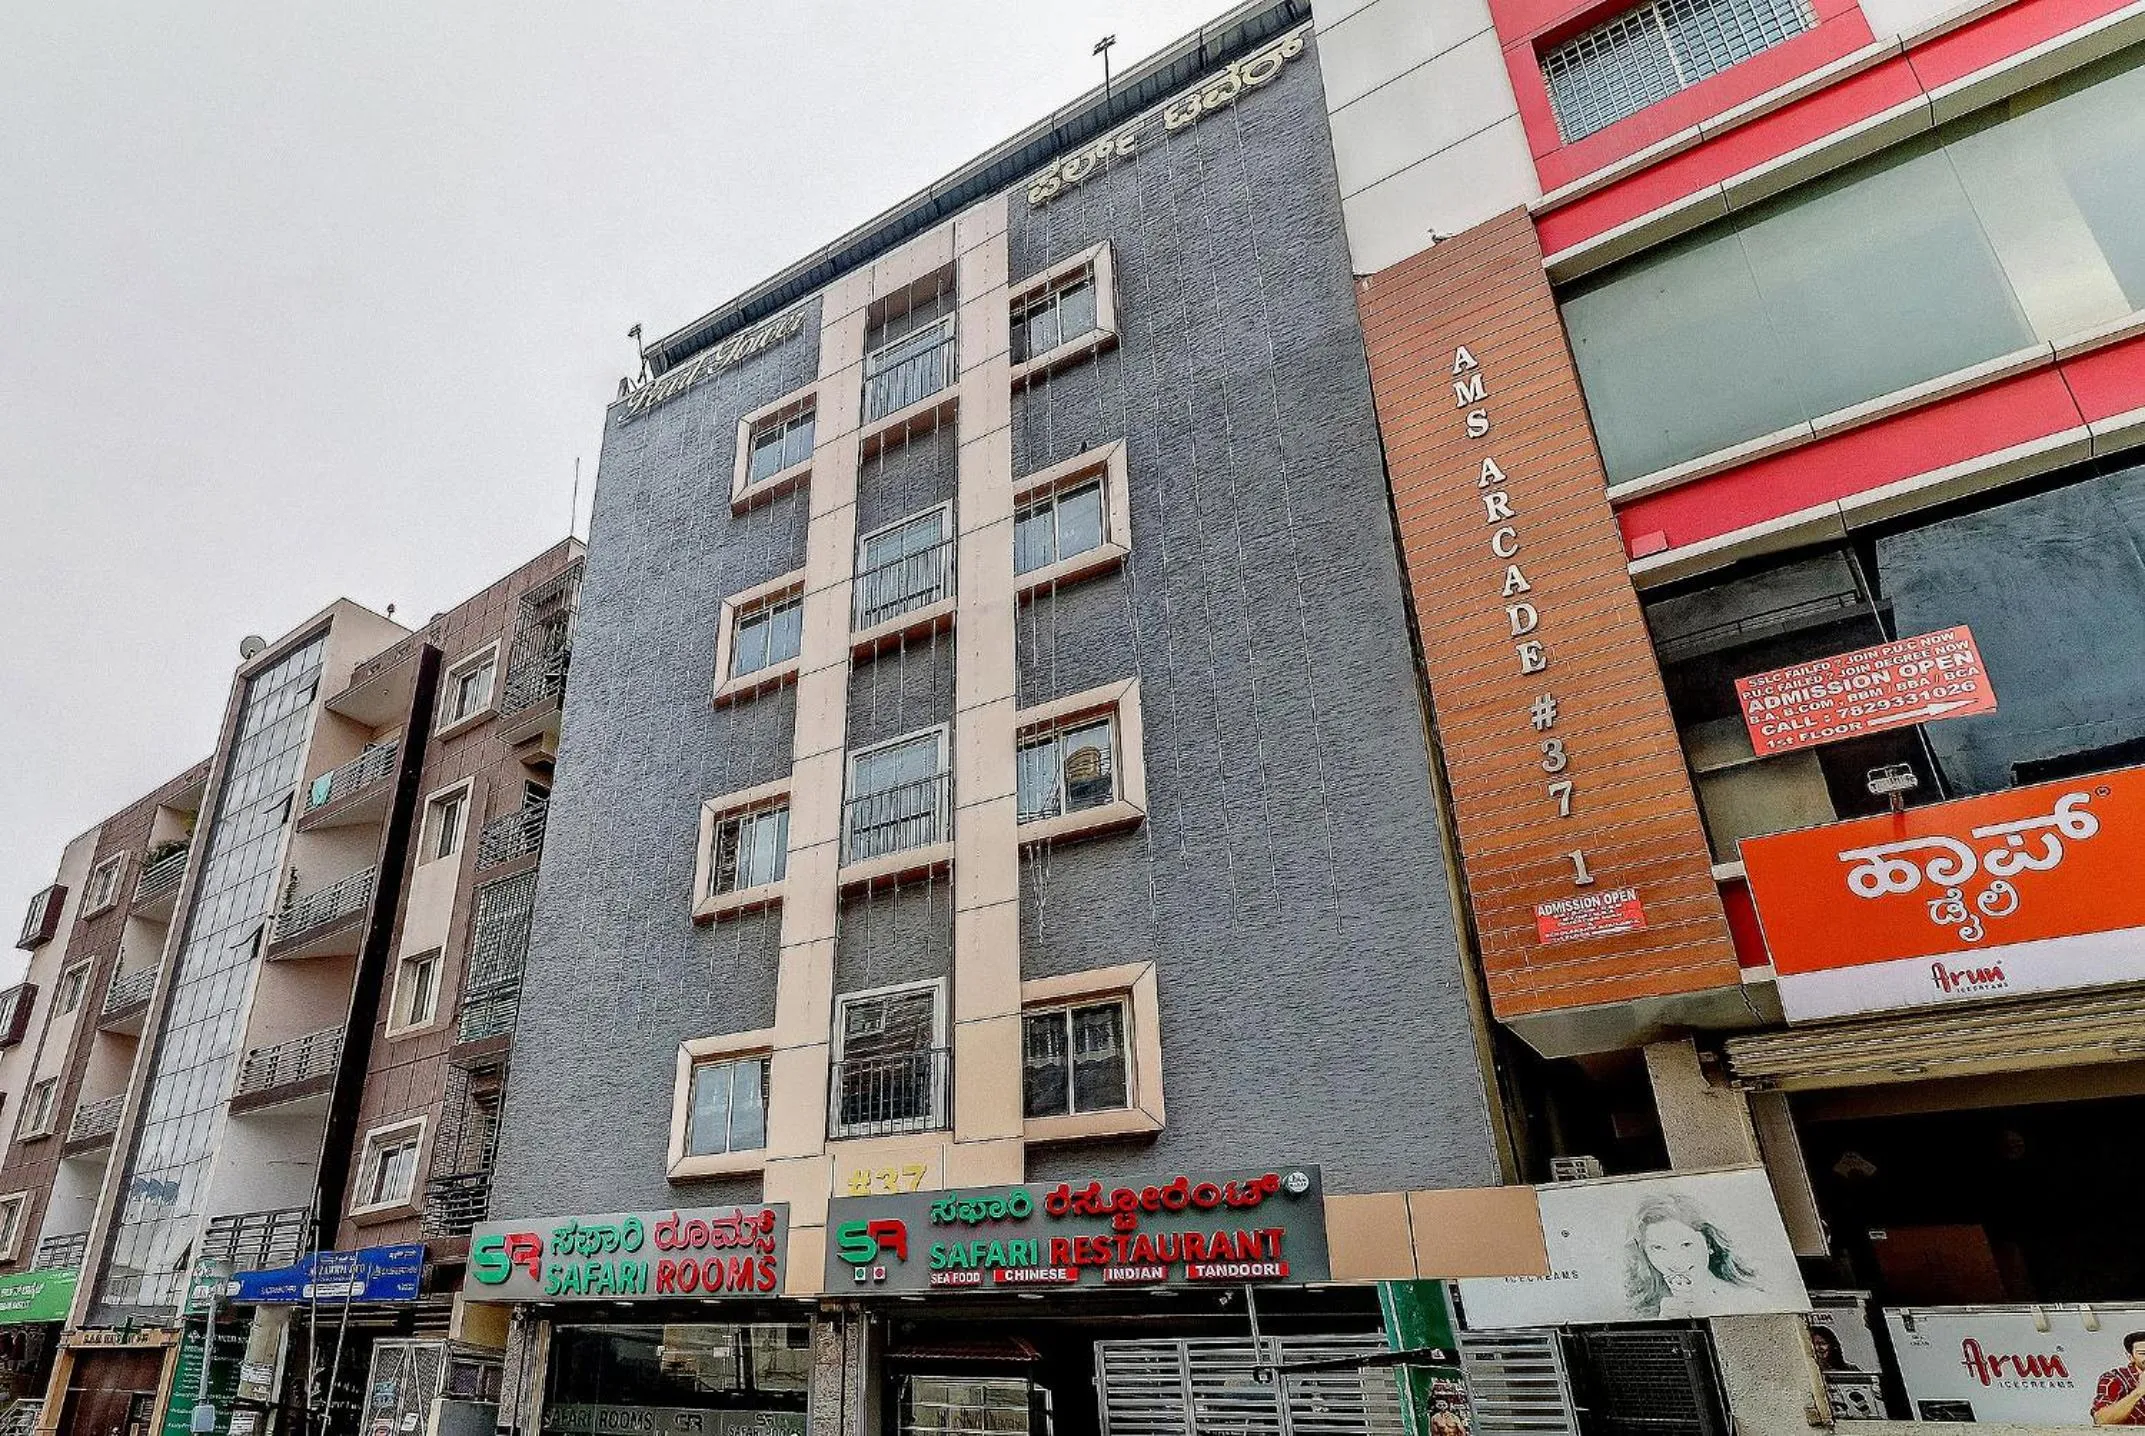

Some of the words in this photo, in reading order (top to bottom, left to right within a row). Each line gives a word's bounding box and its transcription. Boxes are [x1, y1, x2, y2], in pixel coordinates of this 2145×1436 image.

[617, 354, 706, 423] Pearl
[707, 312, 806, 374] Tower
[1451, 345, 1491, 439] AMS
[1477, 456, 1548, 676] ARCADE
[1529, 692, 1575, 818] #37
[1742, 686, 1774, 700] P.U.C
[1778, 675, 1823, 692] FAILED
[1840, 664, 1871, 678] JOIN
[1874, 650, 1931, 670] DEGREE
[1935, 641, 1970, 656] NOW
[1749, 673, 1782, 688] SSLC
[1785, 661, 1831, 678] FAILED
[1845, 650, 1879, 665] JOIN
[1882, 641, 1917, 656] P.U.C
[1921, 632, 1955, 647] NOW
[1748, 669, 1892, 714] ADMISSION
[1898, 650, 1975, 678] OPEN
[1847, 688, 1884, 703] BBM
[1895, 677, 1931, 692] BBA
[1944, 666, 1980, 681] BCA
[1761, 716, 1818, 736] CALL
[1836, 680, 1976, 719] 7829331026
[1766, 736, 1794, 749] 1st
[1799, 722, 1863, 742] FLOOR
[1538, 895, 1601, 917] ADMISSION
[1603, 889, 1637, 906] OPEN
[1927, 880, 2020, 942] ಡೈಲಿ
[1931, 962, 2005, 993] Arun
[848, 1163, 927, 1196] #37
[931, 1188, 1034, 1224] ಸಫಾರಿ
[551, 1214, 644, 1258] ಸಫಾರಿ
[929, 1238, 1039, 1270] SAFARI
[1049, 1228, 1286, 1266] RESTAURANT
[545, 1259, 649, 1296] SAFARI
[656, 1256, 778, 1295] ROOMS
[930, 1273, 950, 1284] SEA
[953, 1272, 981, 1283] FOOD
[1004, 1267, 1067, 1281] CHINESE
[1109, 1265, 1163, 1280] INDIAN
[1195, 1262, 1281, 1278] TANDOORI
[1961, 1338, 2069, 1387] Arun
[1999, 1381, 2075, 1389] ICECREAMS
[599, 1410, 653, 1430] ROOMS
